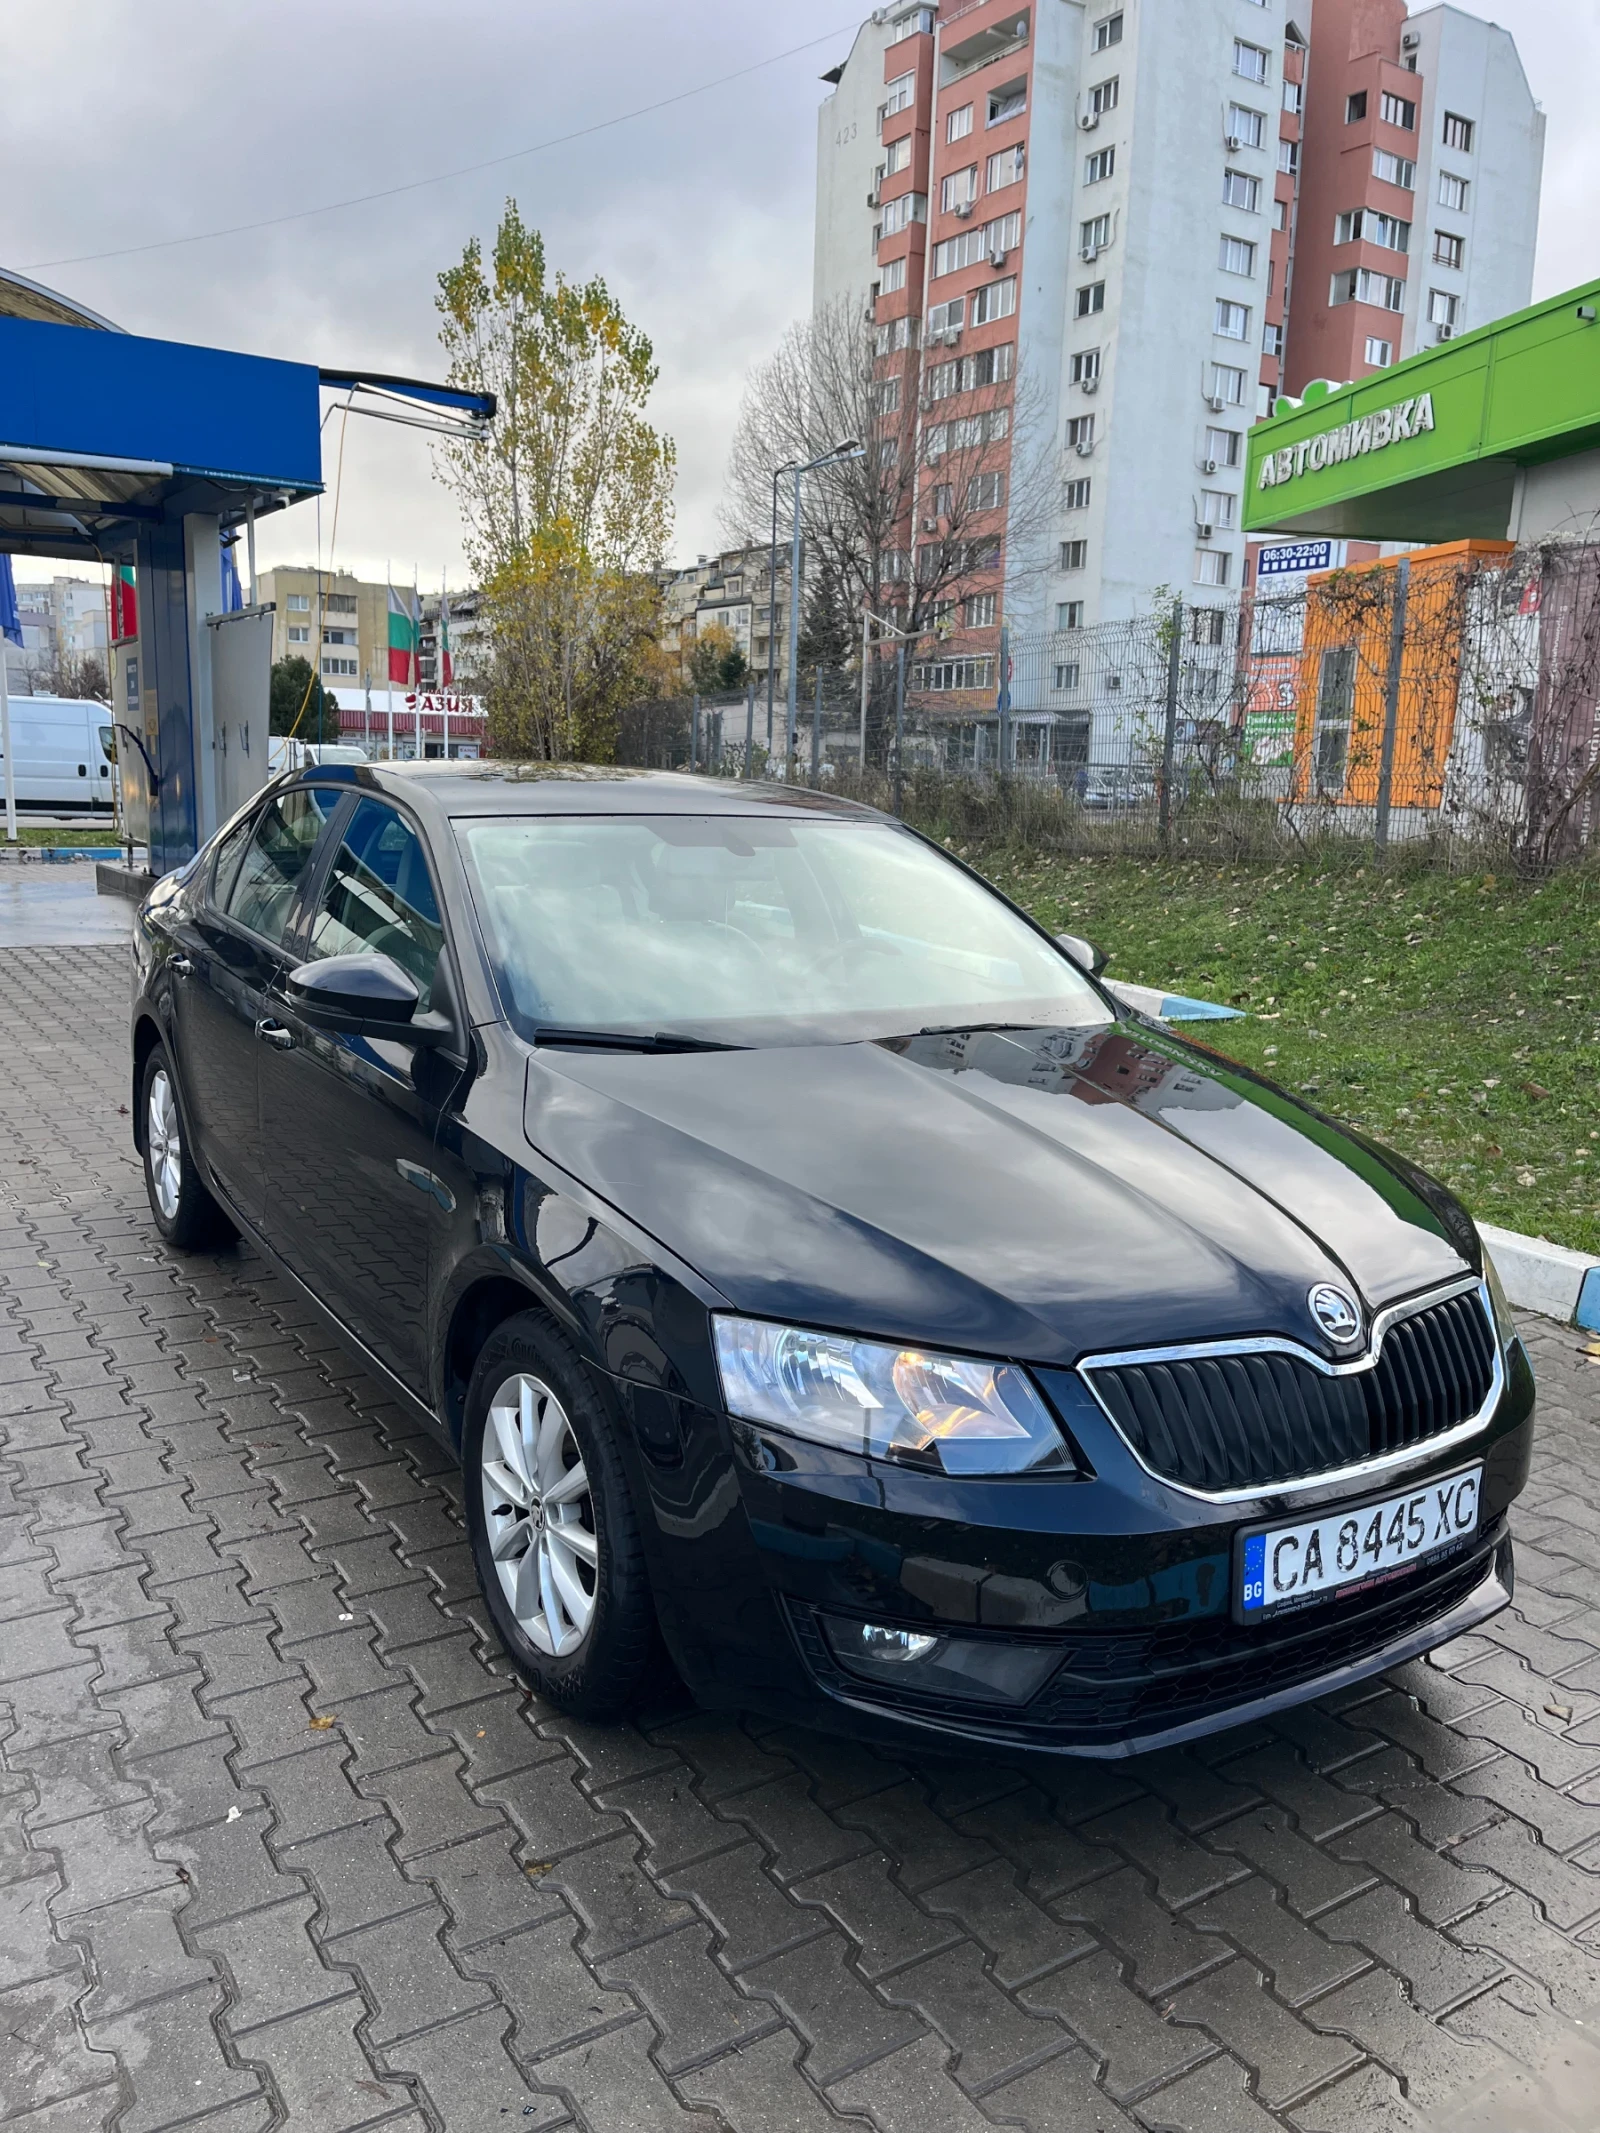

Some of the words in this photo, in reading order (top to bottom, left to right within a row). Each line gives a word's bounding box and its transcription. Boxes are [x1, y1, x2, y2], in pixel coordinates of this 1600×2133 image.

[835, 122, 857, 147] 423
[1256, 393, 1435, 489] АВТОМИВКА
[1263, 543, 1327, 562] 06:30-22:00
[1273, 1529, 1323, 1592] CA
[1337, 1497, 1426, 1573] 8445
[1434, 1478, 1475, 1540] XC
[1244, 1581, 1262, 1601] BG
